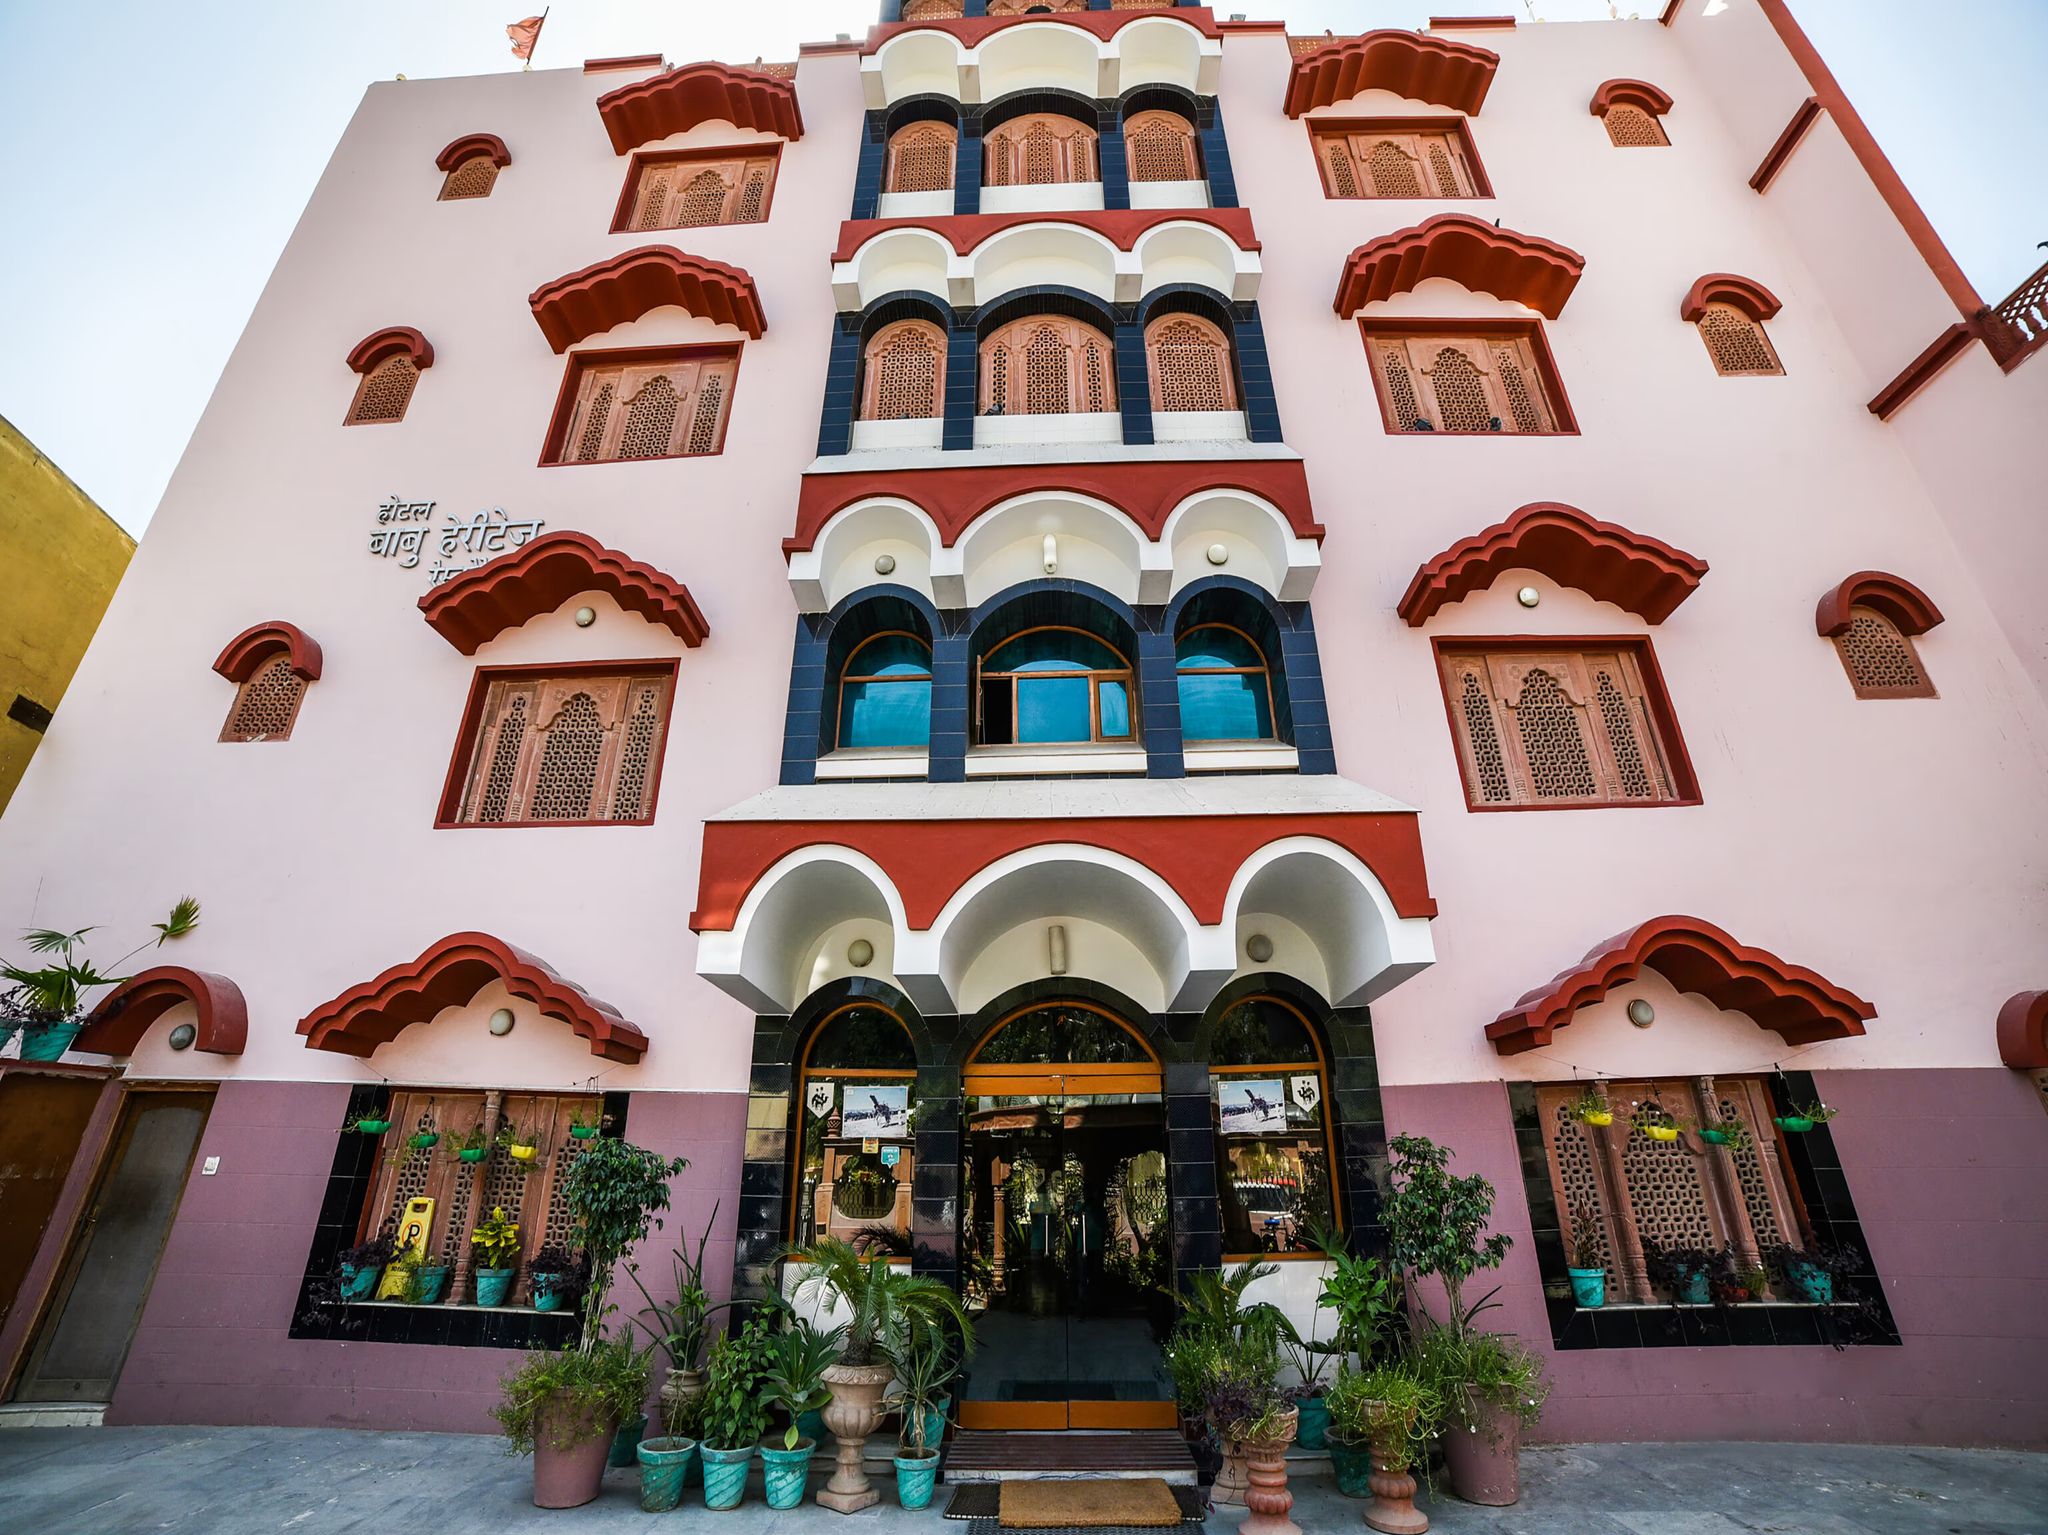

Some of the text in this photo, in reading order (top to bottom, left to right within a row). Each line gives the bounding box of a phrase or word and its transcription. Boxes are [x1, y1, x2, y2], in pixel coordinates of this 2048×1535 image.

[377, 494, 436, 525] होटल
[368, 507, 545, 568] बाबु हेरीटेज
[408, 1224, 420, 1240] P
